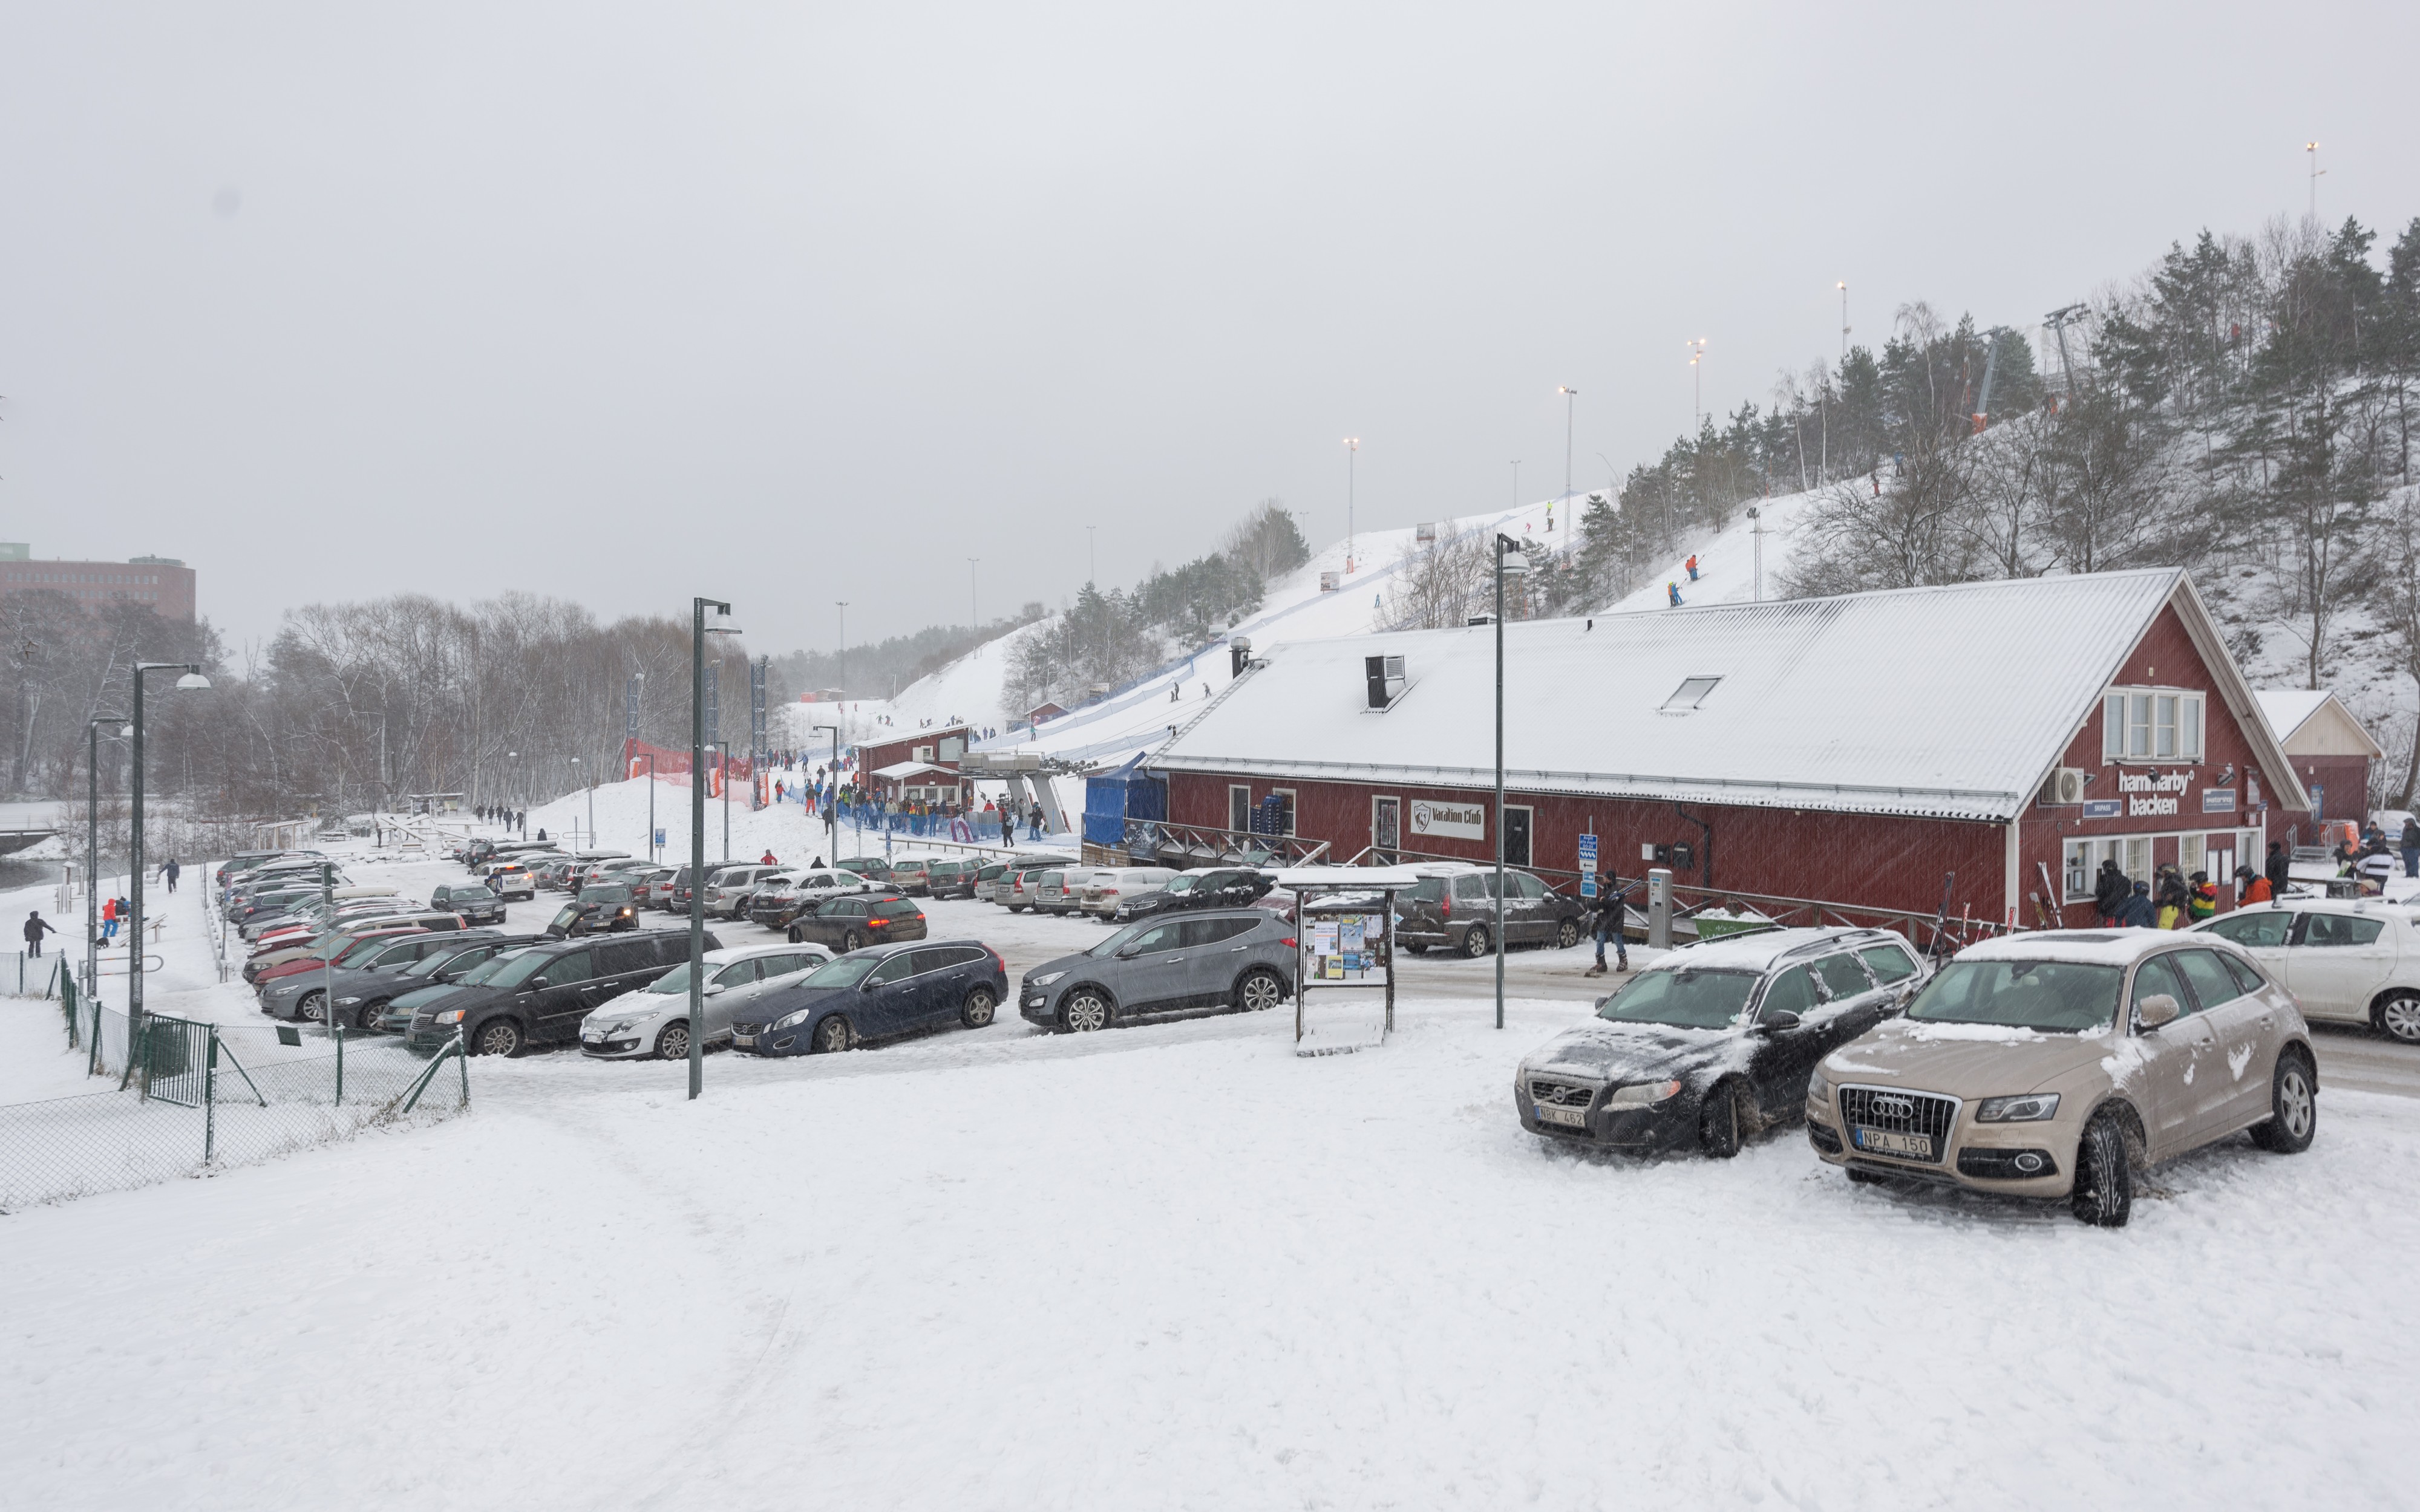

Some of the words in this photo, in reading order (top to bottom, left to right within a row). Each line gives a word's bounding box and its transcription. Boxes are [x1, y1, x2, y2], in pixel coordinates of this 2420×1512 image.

[2129, 793, 2177, 816] backen
[1432, 807, 1462, 824] Vacation
[1464, 809, 1482, 825] Club
[1540, 1109, 1557, 1122] NBK
[1564, 1112, 1583, 1126] 462
[1864, 1132, 1890, 1148] NPA
[1902, 1136, 1928, 1153] 150
